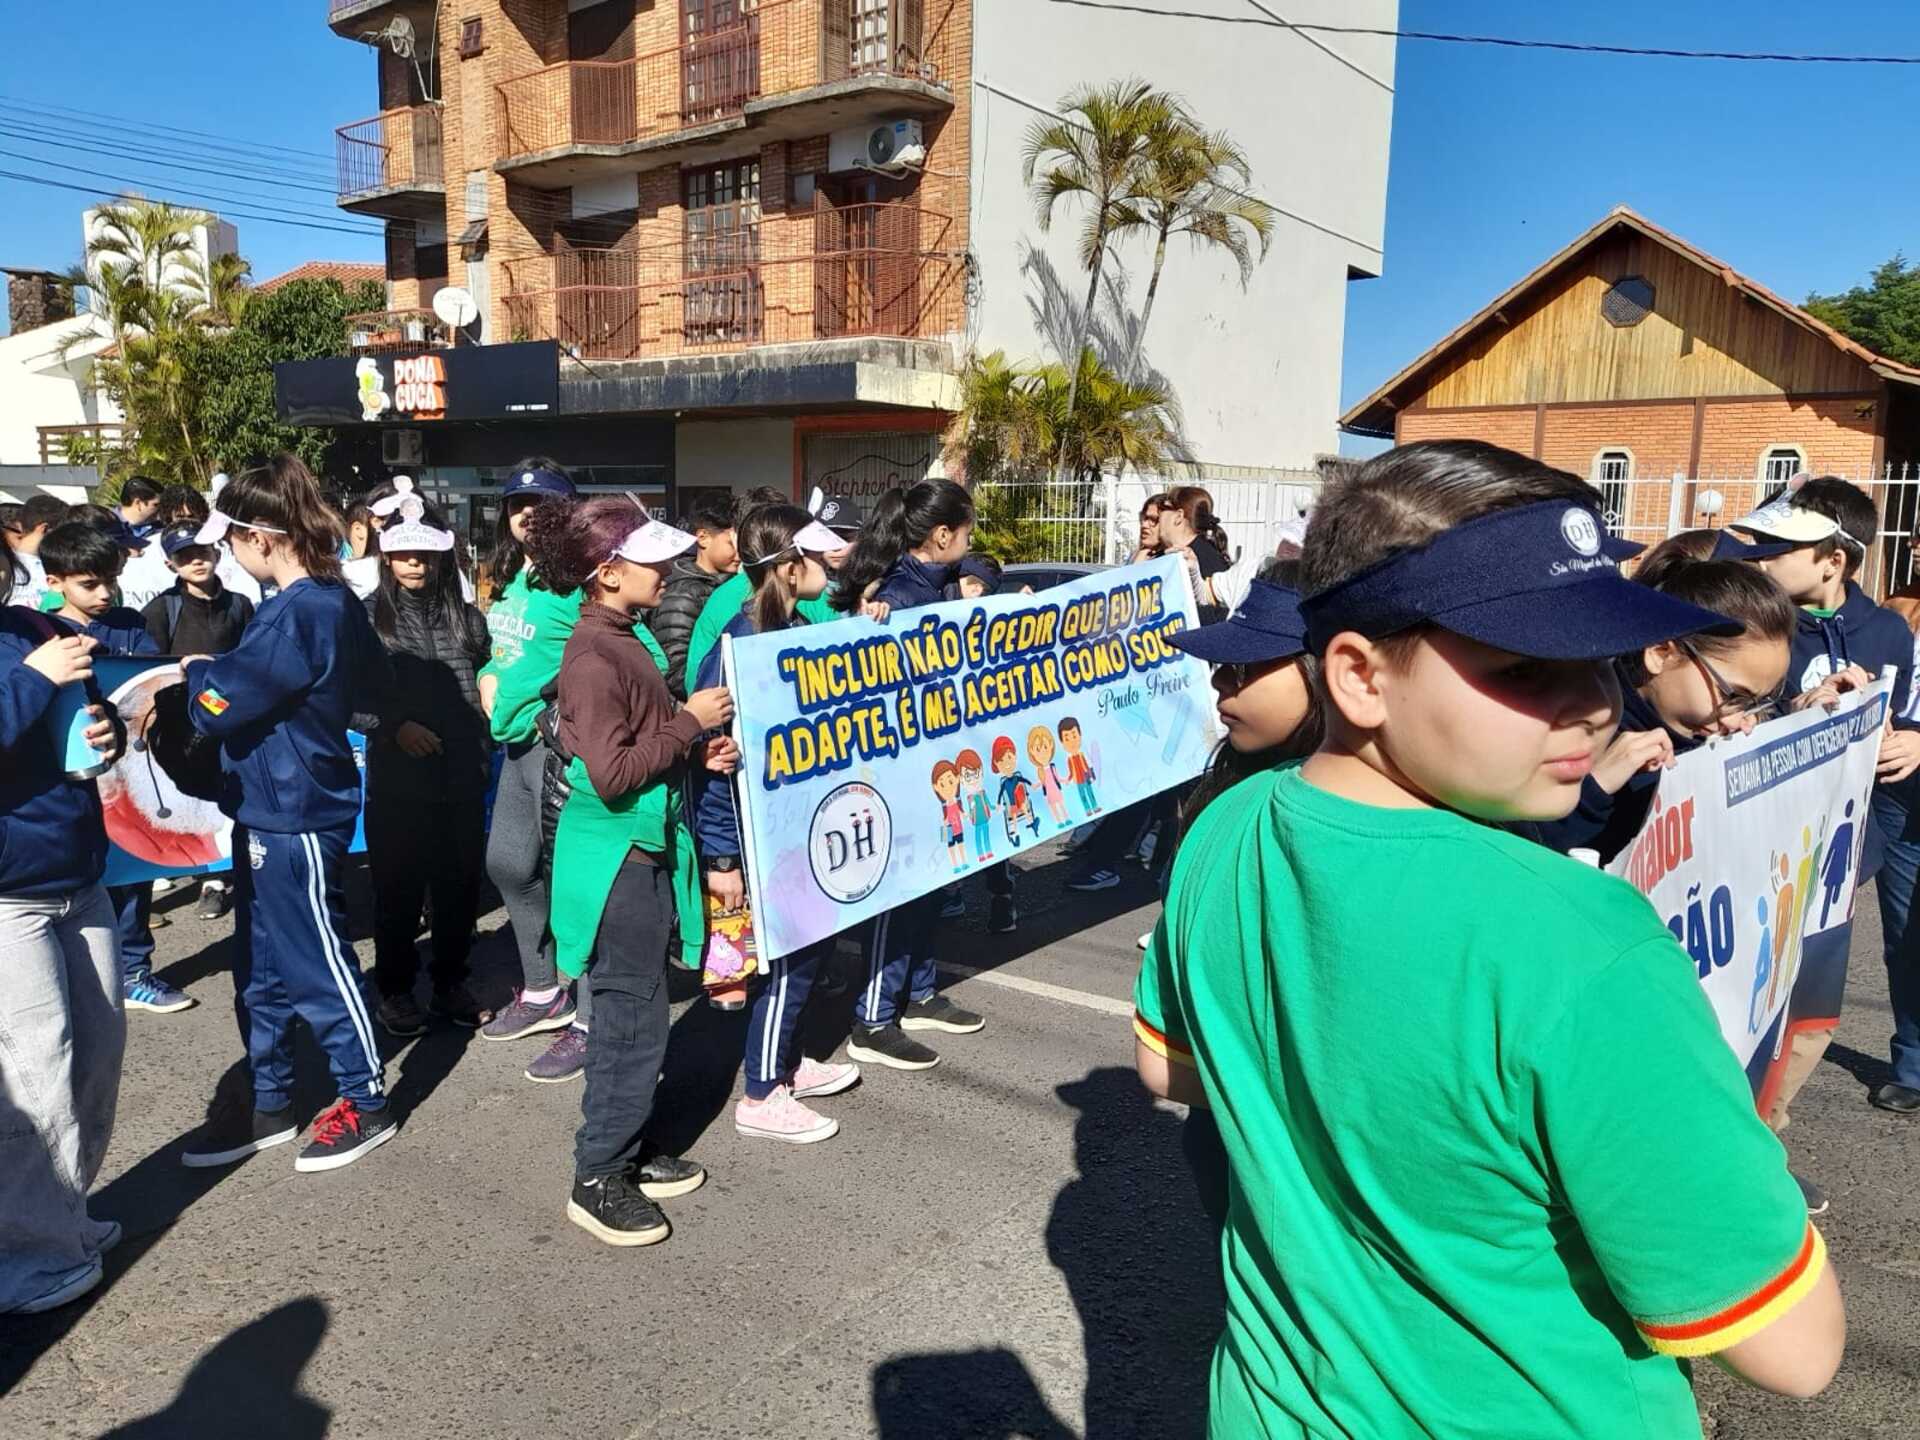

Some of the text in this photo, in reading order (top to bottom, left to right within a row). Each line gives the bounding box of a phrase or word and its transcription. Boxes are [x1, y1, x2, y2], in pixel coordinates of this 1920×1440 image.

[394, 355, 438, 385] DONA
[395, 383, 438, 412] CUCA
[904, 622, 962, 677] NÃO
[966, 614, 982, 663] É
[990, 610, 1057, 658] PEDIR
[1063, 597, 1106, 640] QUE
[1109, 589, 1133, 628] EU
[1137, 582, 1162, 619] ME
[768, 706, 896, 782] ADAPTE,
[899, 687, 917, 740] É
[924, 686, 958, 732] ME
[965, 657, 1061, 719] ACEITAR
[1065, 640, 1127, 687] COMO
[1097, 684, 1139, 717] Paulo
[1728, 756, 1762, 798] SEMANA
[1761, 757, 1772, 784] DA
[1770, 743, 1797, 778] PESSOA
[1796, 735, 1813, 765] COM
